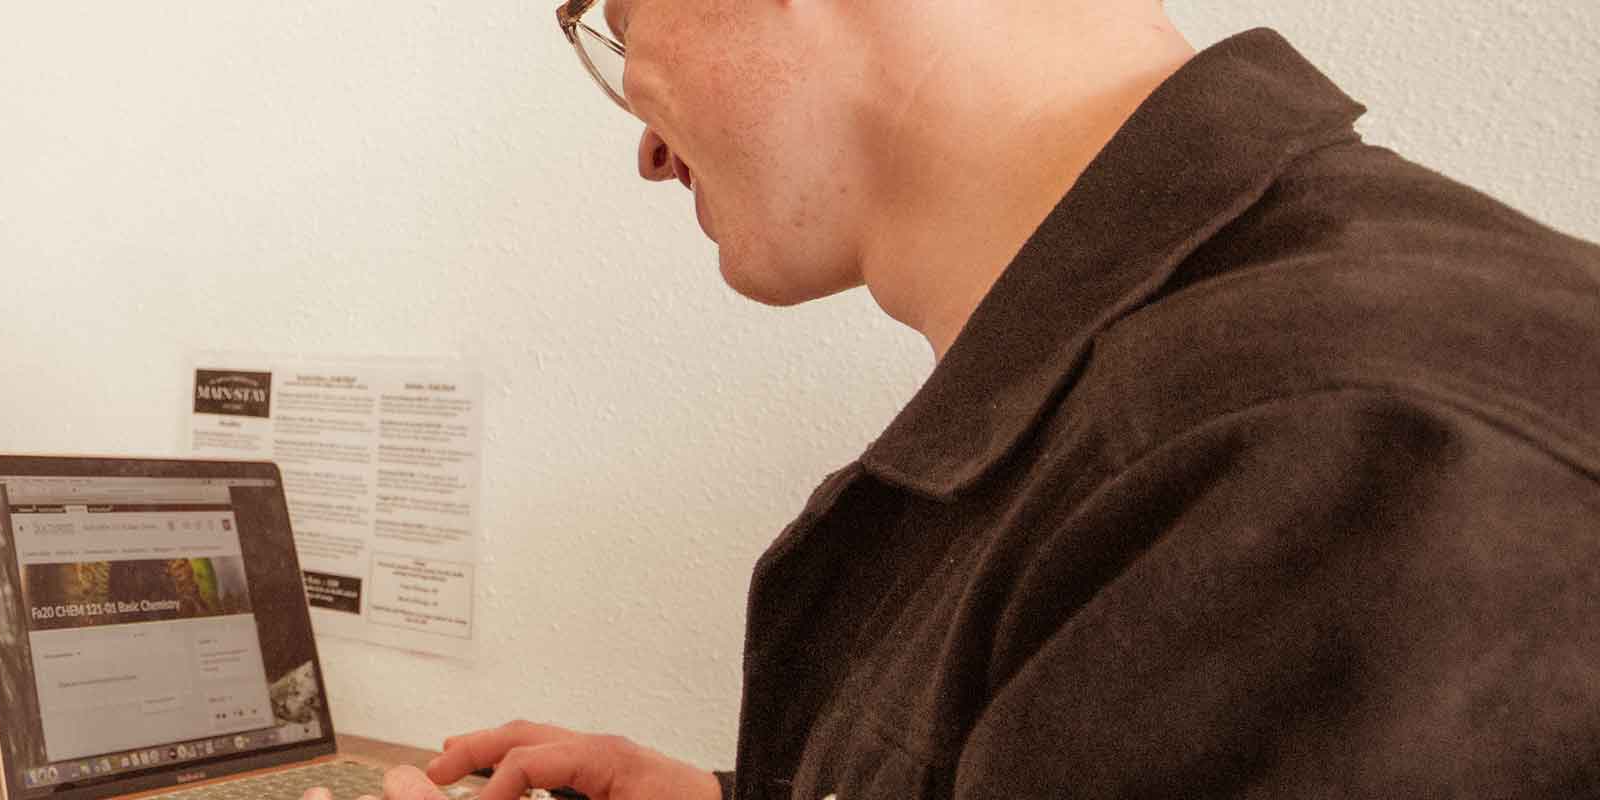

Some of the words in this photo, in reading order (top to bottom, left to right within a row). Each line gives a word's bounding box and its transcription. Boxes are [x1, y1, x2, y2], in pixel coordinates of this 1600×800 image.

[55, 605, 83, 617] CHEM
[85, 603, 117, 616] 121-01
[118, 601, 139, 613] Basic
[140, 599, 180, 613] Chemistry
